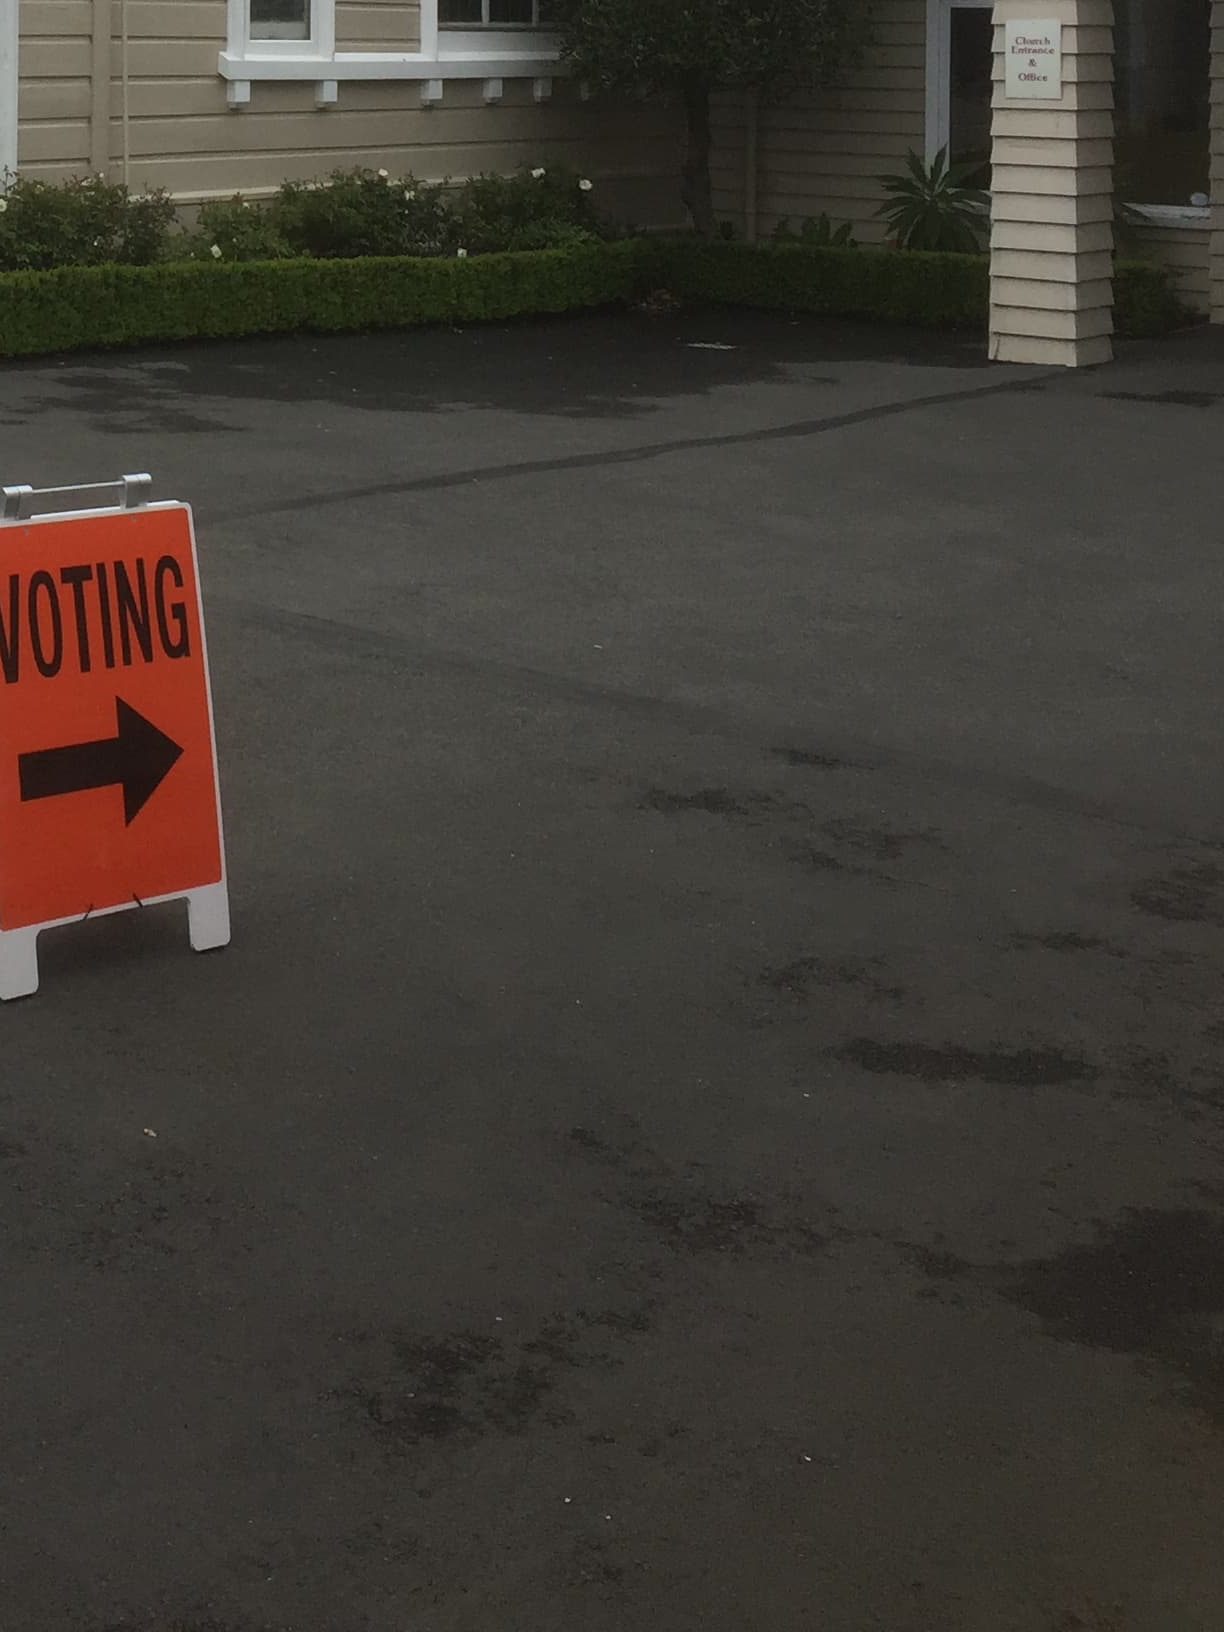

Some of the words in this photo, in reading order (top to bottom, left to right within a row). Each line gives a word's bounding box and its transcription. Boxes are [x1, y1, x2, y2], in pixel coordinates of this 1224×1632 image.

[1015, 36, 1051, 45] Church
[1011, 46, 1055, 55] Entrance
[1028, 58, 1037, 67] &
[1018, 72, 1048, 82] Office
